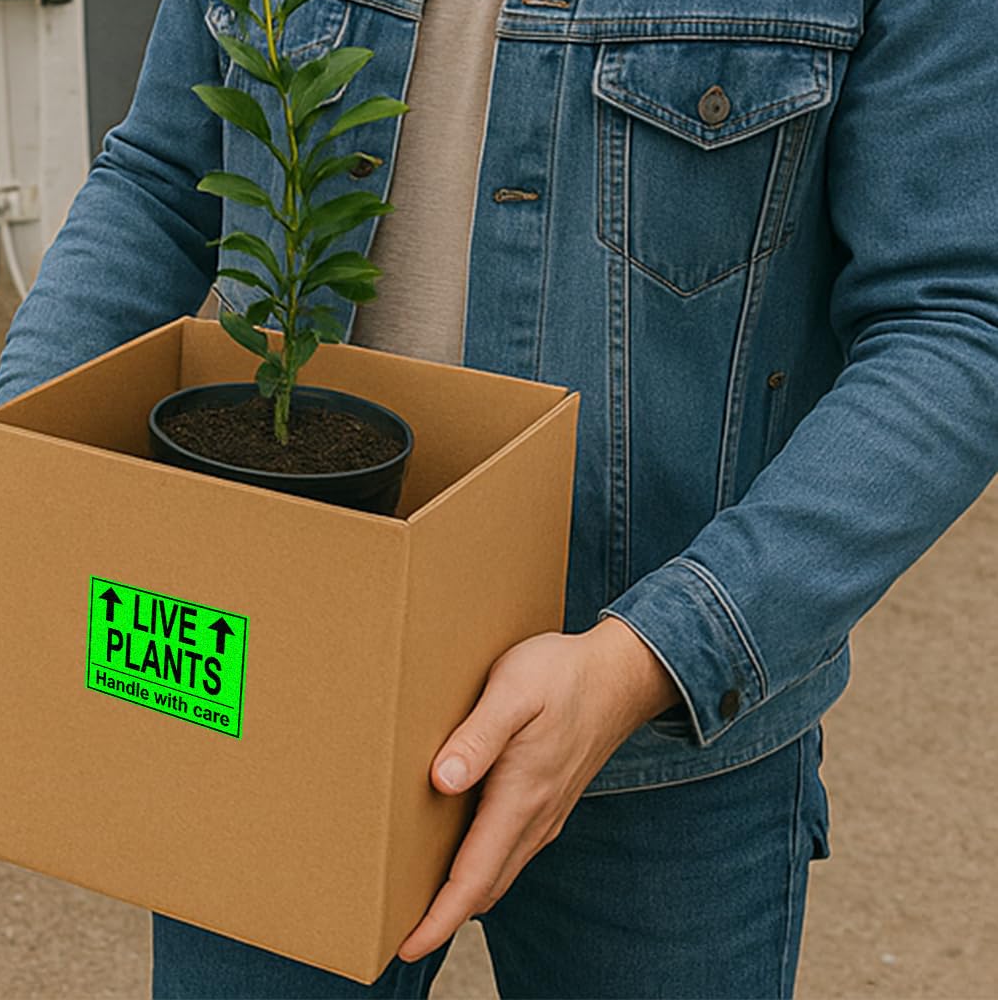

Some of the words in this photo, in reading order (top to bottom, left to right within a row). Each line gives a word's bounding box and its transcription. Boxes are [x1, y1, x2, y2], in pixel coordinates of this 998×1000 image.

[133, 594, 198, 647] LIVE
[106, 627, 222, 696] PLANTS
[95, 669, 150, 701] Handle
[154, 691, 188, 714] with
[193, 704, 230, 727] care
